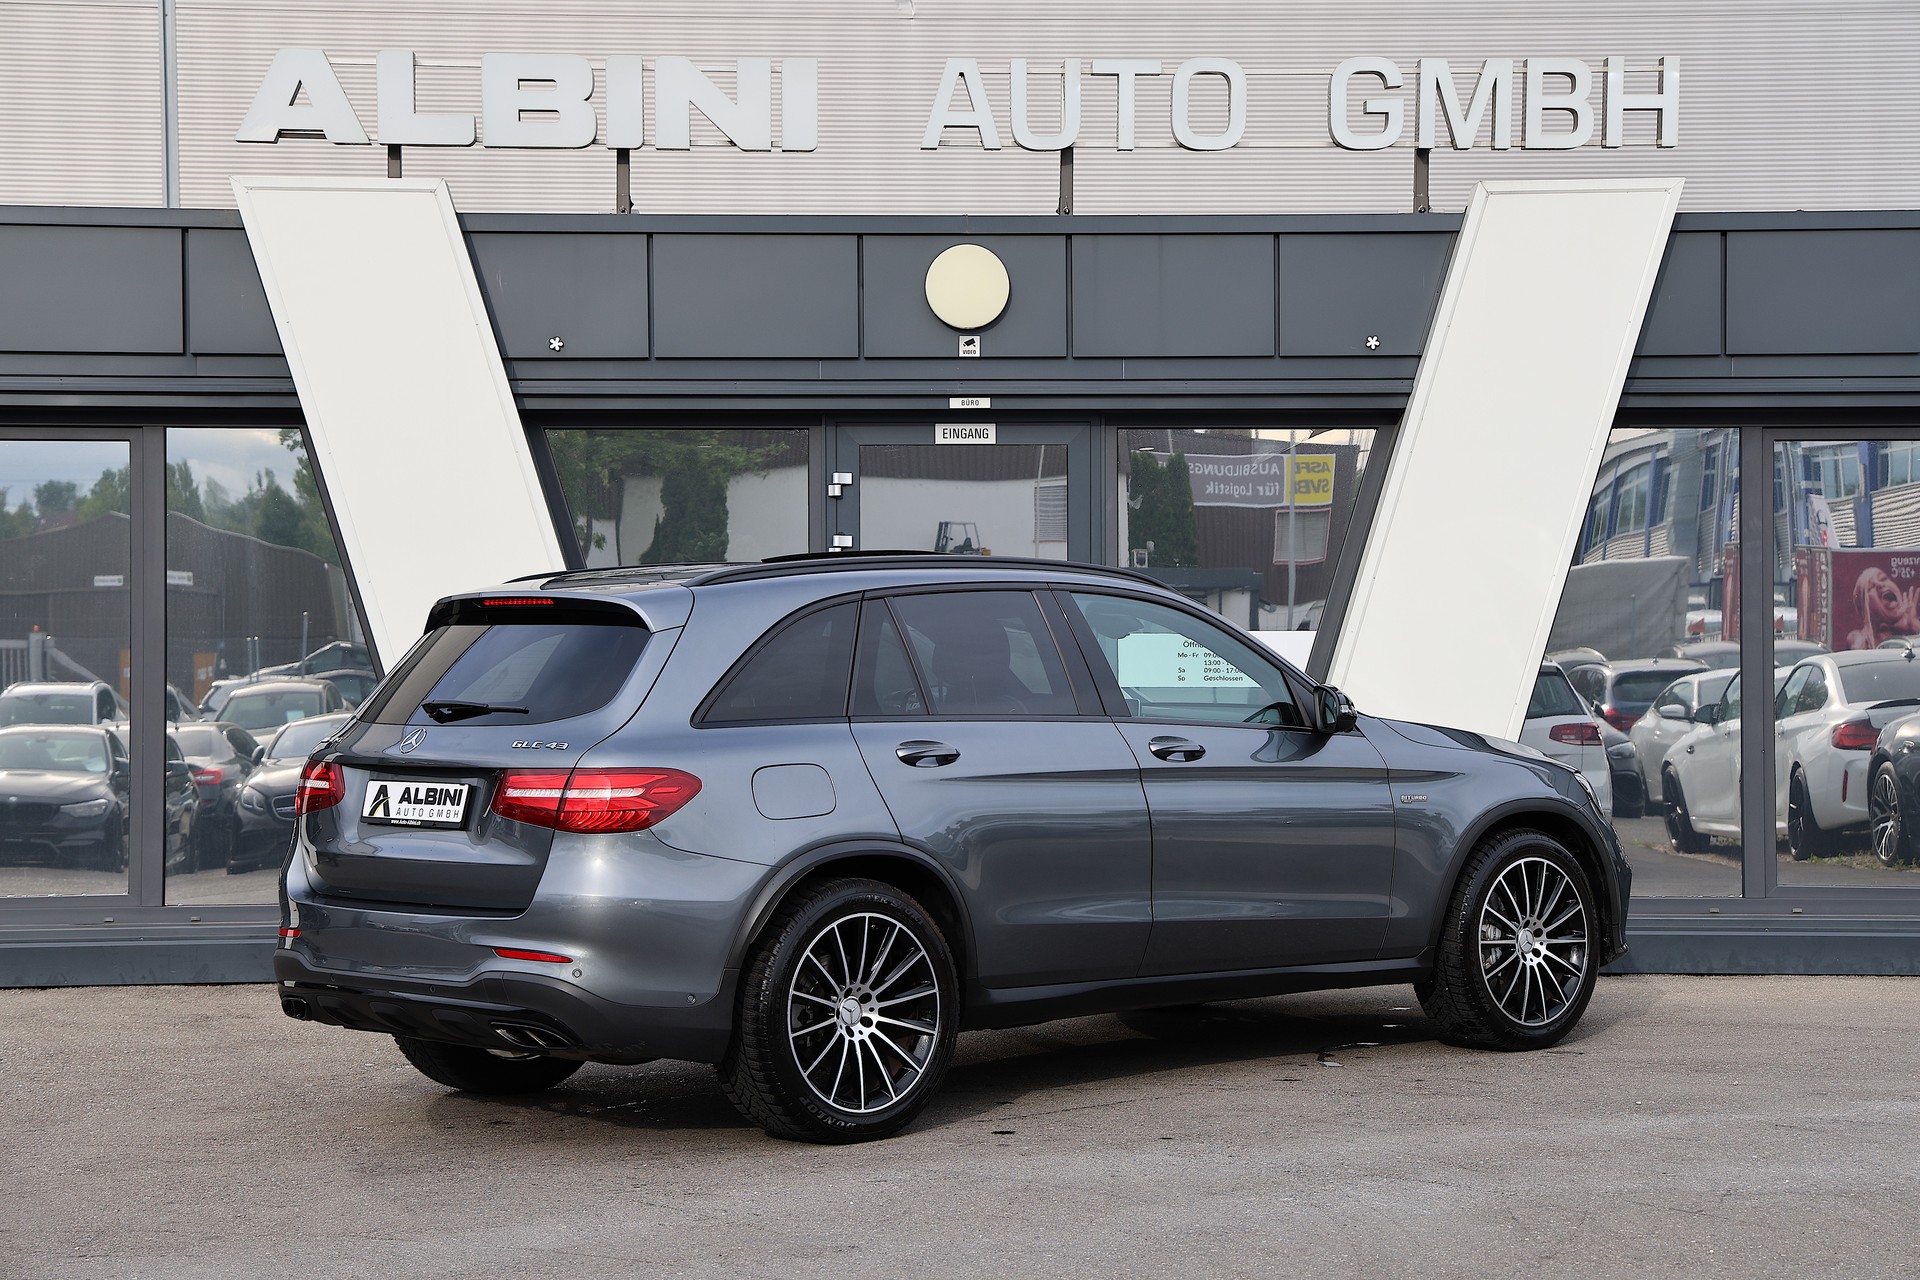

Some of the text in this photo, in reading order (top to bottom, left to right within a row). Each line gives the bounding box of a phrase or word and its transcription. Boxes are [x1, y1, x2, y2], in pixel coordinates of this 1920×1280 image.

[234, 48, 1681, 152] ALBINI AUTO GMBH
[961, 398, 980, 406] BÜRO
[942, 428, 989, 439] EINGANG
[512, 740, 569, 750] GLC 43
[398, 786, 463, 806] ALBINI
[395, 807, 460, 819] AUTO GMBH
[799, 1096, 857, 1130] DUNLOP
